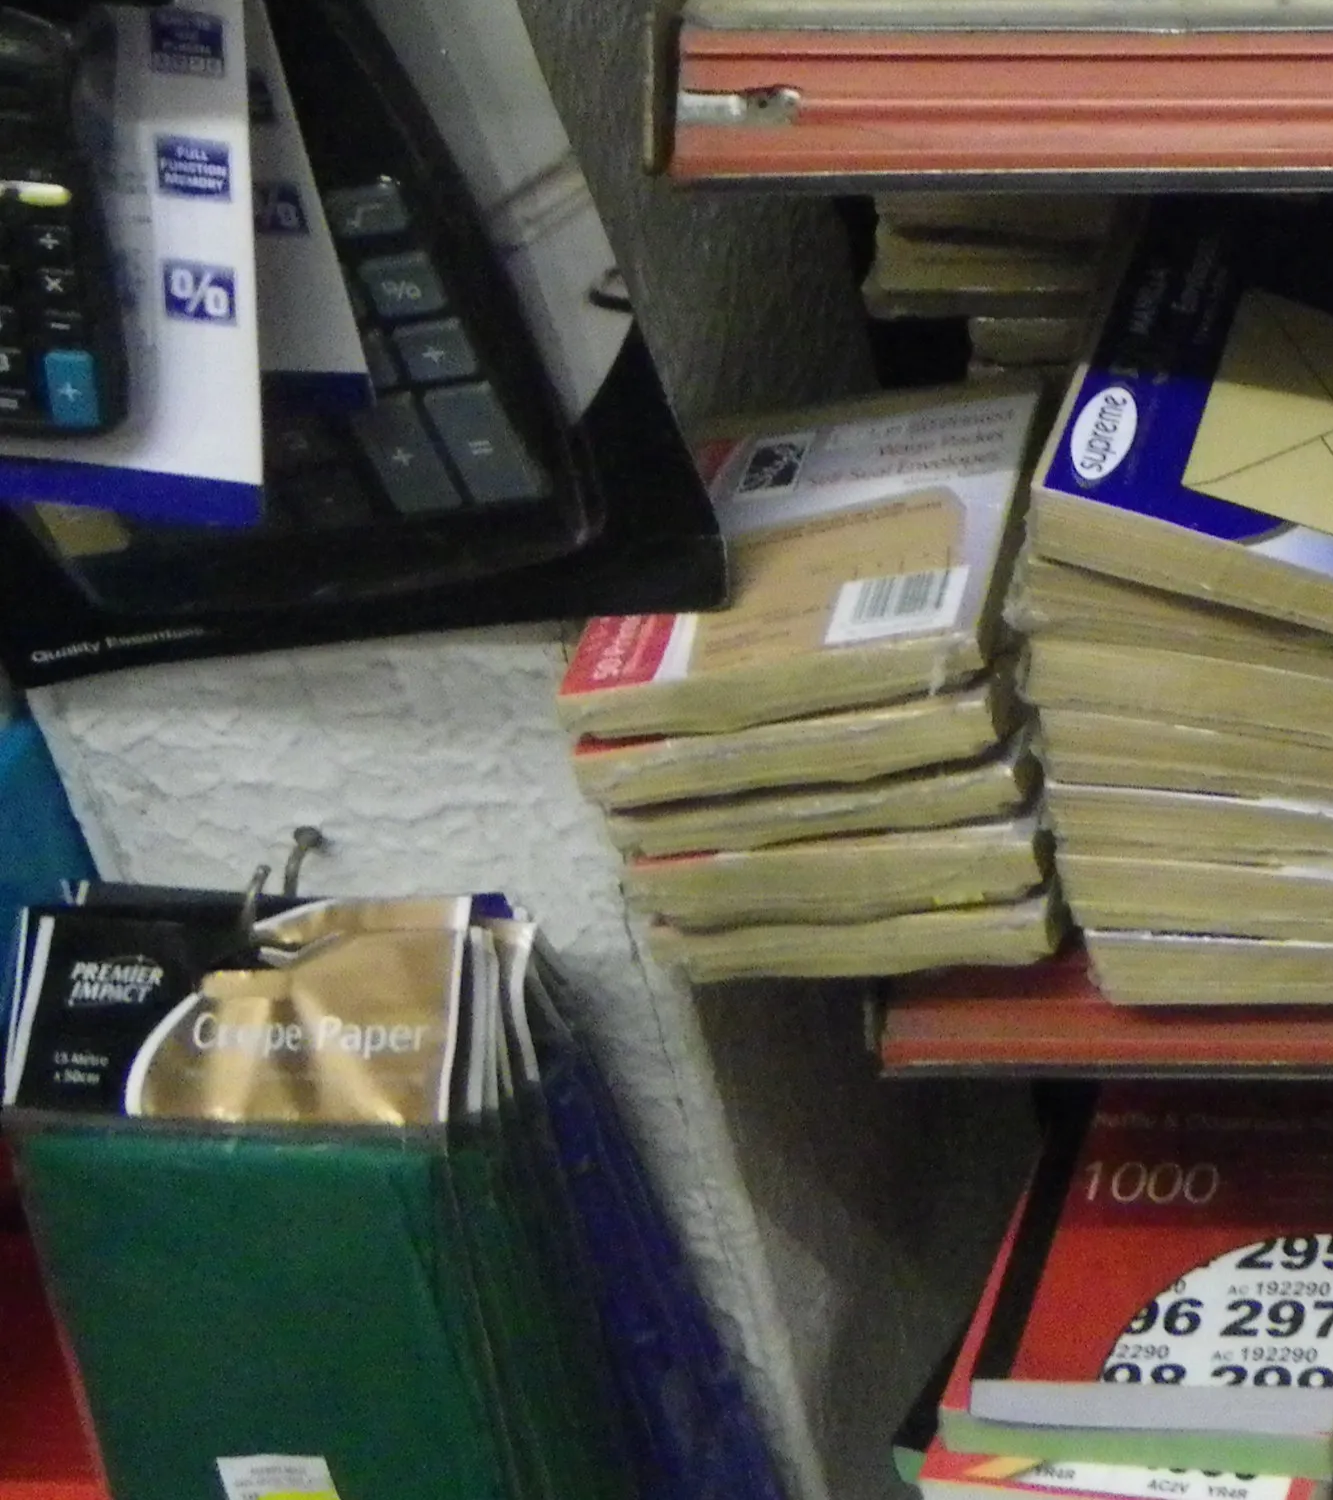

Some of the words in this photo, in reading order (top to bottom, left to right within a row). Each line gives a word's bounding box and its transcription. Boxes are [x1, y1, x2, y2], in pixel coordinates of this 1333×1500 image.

[1080, 392, 1128, 474] supreme
[30, 638, 102, 664] Quality
[69, 959, 165, 988] PREMIER
[70, 979, 151, 1004] IMPACT
[315, 1015, 430, 1061] Paper
[1083, 1161, 1221, 1206] 1000
[1255, 1280, 1331, 1298] 192290
[1240, 1346, 1318, 1364] 192290
